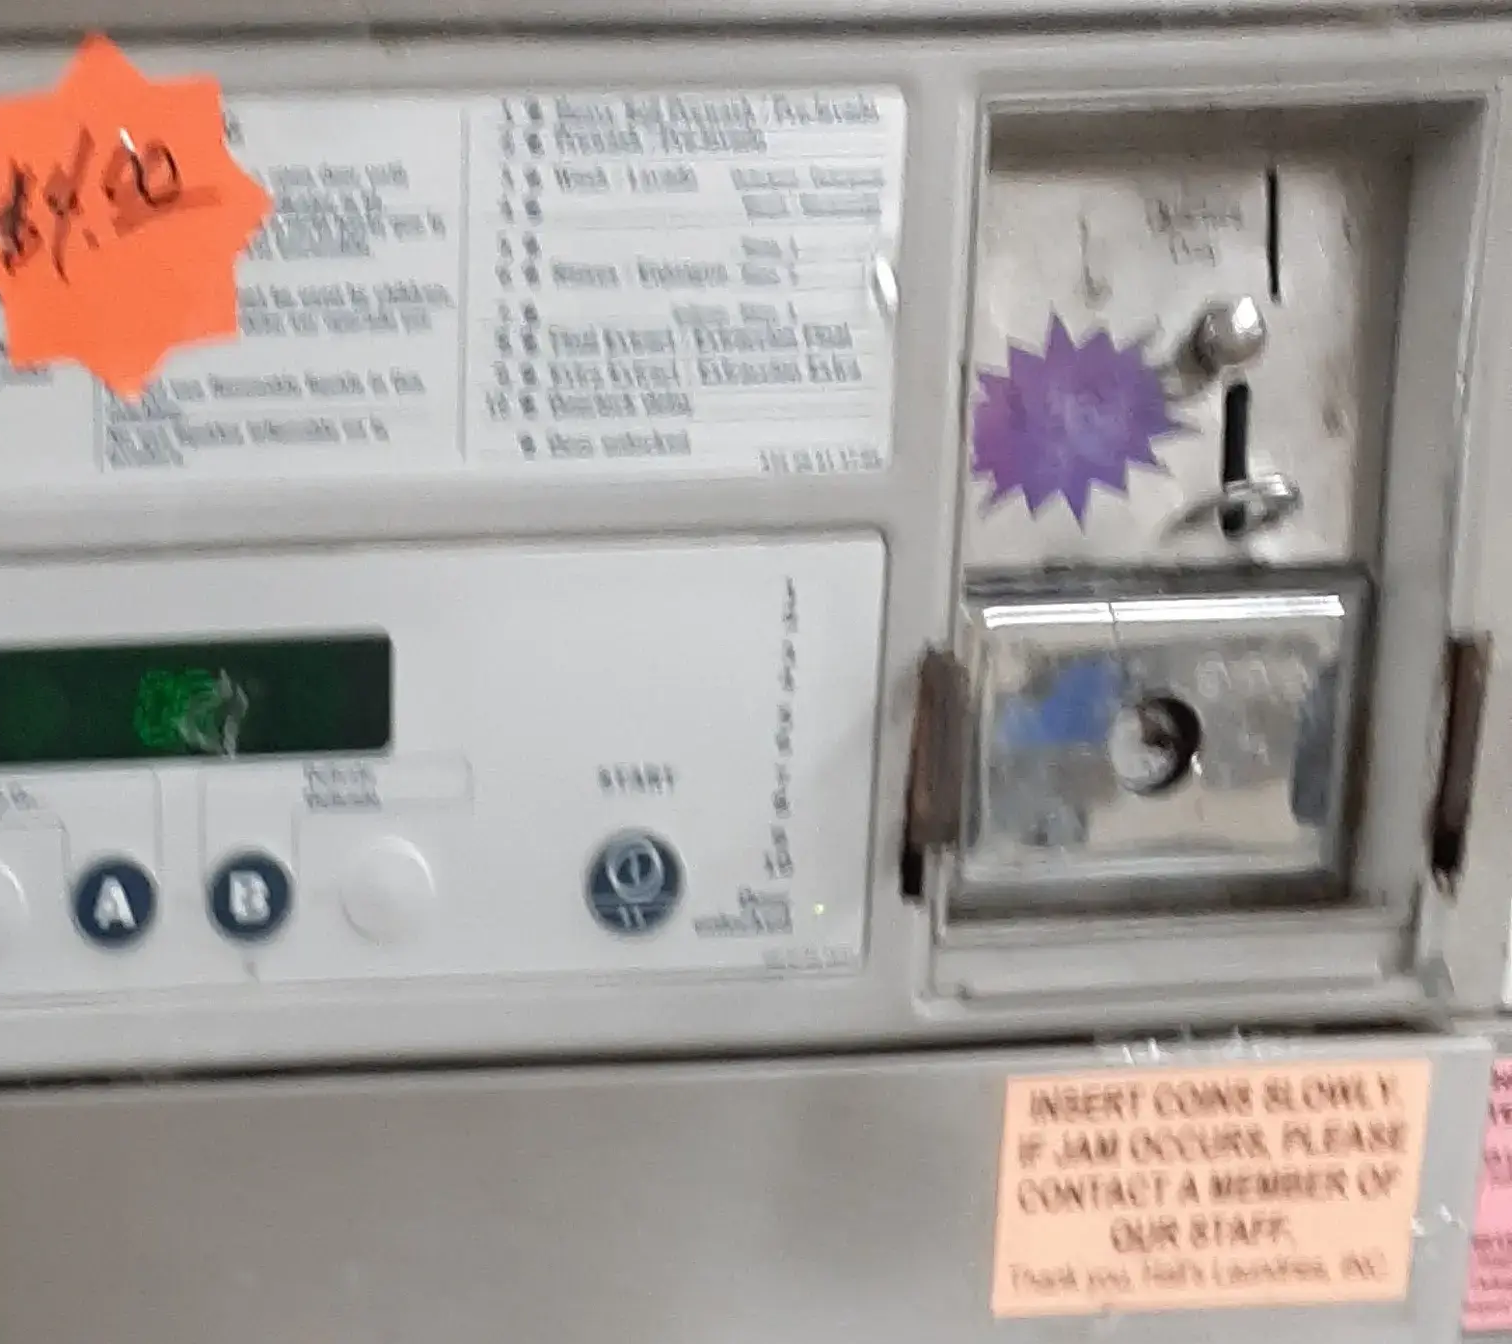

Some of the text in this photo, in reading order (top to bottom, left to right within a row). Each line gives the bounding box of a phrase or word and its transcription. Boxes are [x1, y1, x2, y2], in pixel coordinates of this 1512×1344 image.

[92, 874, 139, 932] A
[227, 868, 272, 926] B
[1029, 1078, 1143, 1122] INSERT
[1153, 1076, 1254, 1118] COINS
[1017, 1131, 1048, 1169] IF
[1054, 1129, 1121, 1168] JAM
[1282, 1118, 1407, 1157] PLEASE
[1016, 1161, 1403, 1215] CONTACT A MEMBER OF
[1109, 1215, 1181, 1254] OUR
